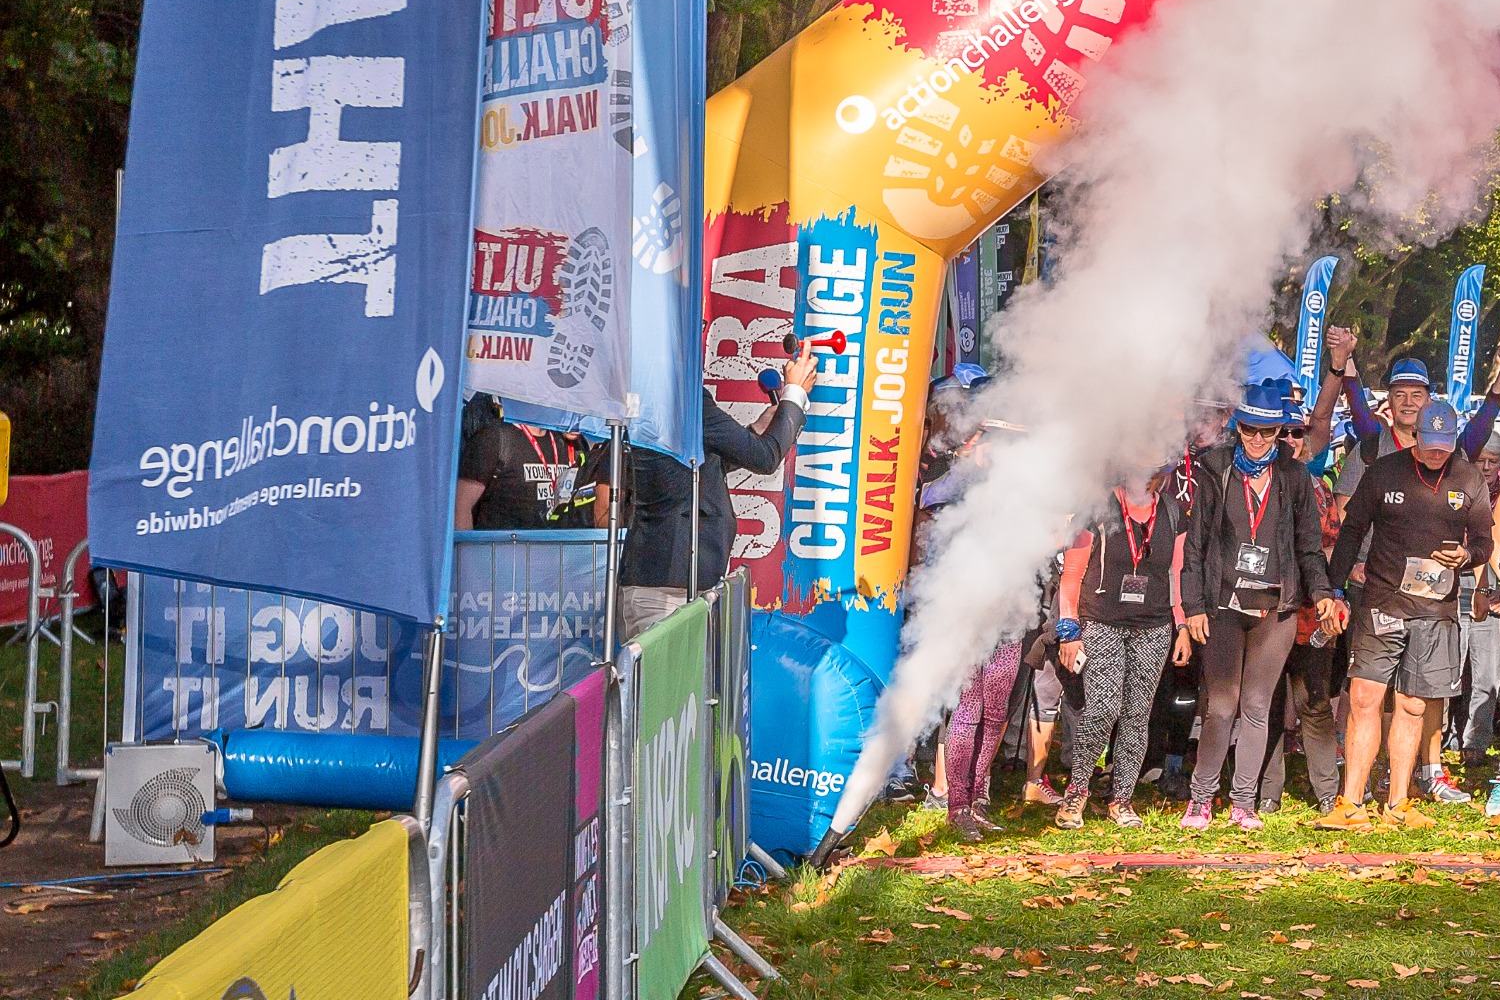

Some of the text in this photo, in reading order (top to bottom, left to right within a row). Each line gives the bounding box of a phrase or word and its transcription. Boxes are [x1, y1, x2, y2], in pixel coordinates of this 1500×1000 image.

[878, 250, 917, 337] RUN
[1300, 317, 1320, 379] Allianz
[1452, 324, 1472, 385] Allianz
[1384, 491, 1405, 504] NS
[641, 692, 698, 948] NSPCC
